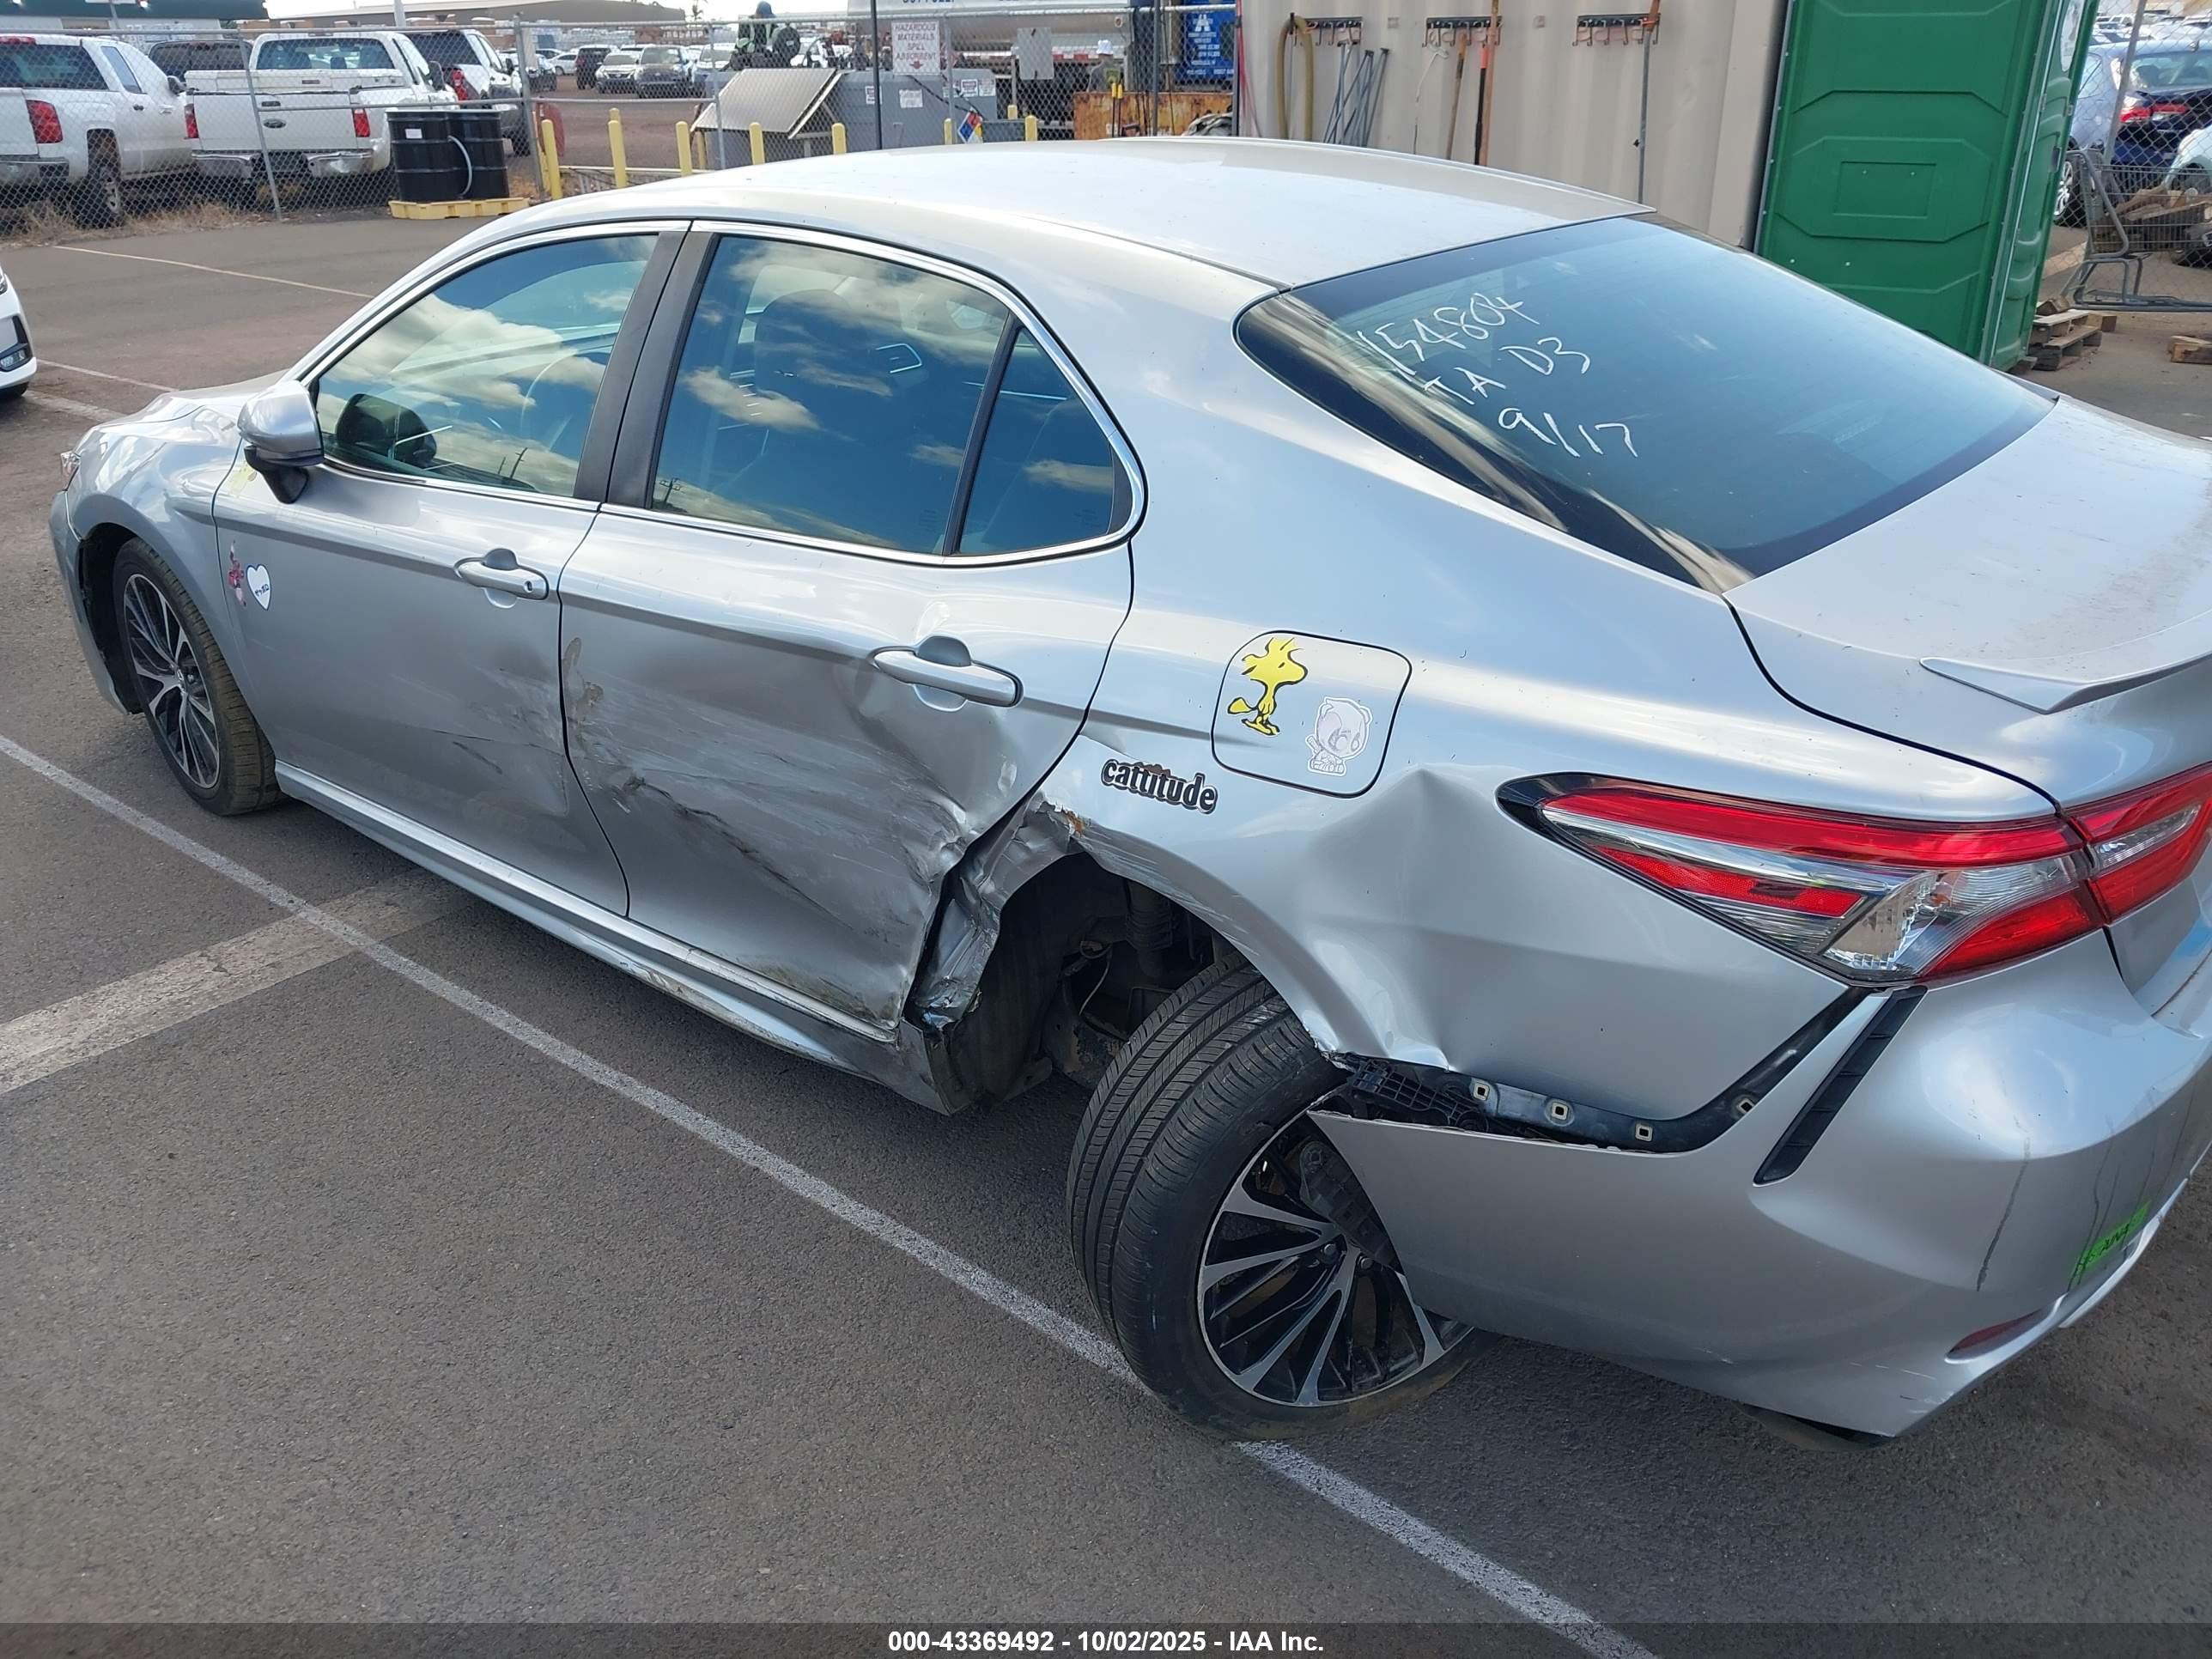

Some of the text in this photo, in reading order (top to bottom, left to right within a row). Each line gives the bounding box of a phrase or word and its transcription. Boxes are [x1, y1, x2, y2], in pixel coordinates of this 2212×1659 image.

[895, 23, 936, 32] HAZARDOUS
[897, 33, 935, 41] MATERIALS
[907, 42, 926, 51] SPILL
[1499, 337, 1591, 375] D3
[1498, 407, 1638, 458] 9/17
[1103, 761, 1215, 811] cattitude
